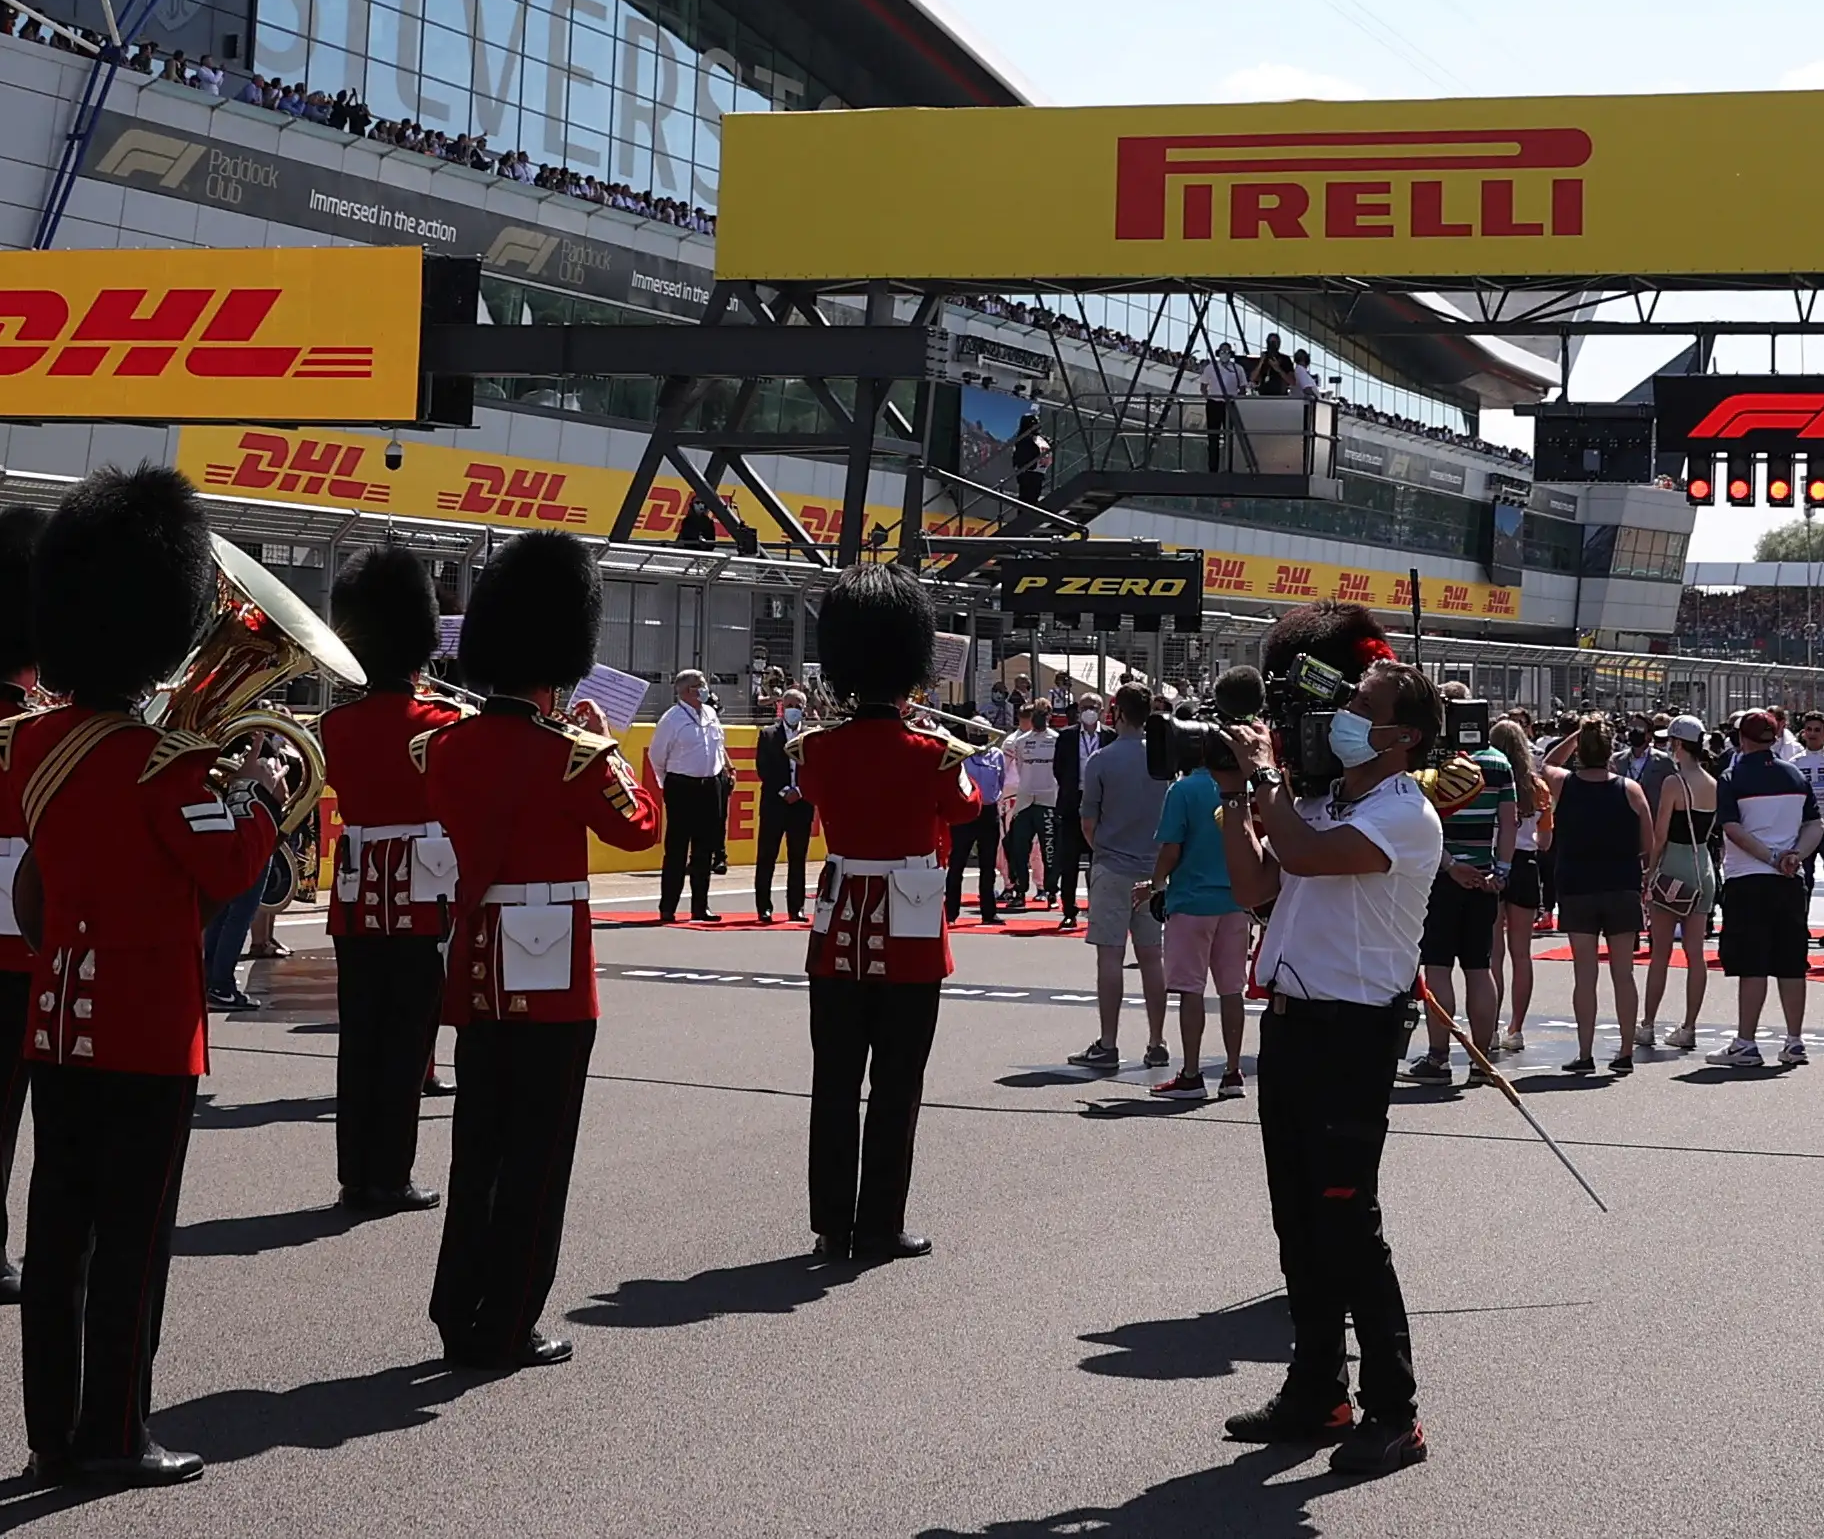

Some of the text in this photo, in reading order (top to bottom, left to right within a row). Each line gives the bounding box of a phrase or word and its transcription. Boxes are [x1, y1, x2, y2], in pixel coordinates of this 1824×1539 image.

[210, 149, 279, 189] Paddock
[1116, 128, 1592, 240] PIRELLI
[206, 174, 242, 204] Club
[309, 189, 457, 243] Immersed in the action
[562, 240, 612, 271] Paddock
[632, 270, 681, 298] Immersed
[682, 285, 691, 300] in
[692, 288, 710, 304] the
[231, 432, 371, 502] DHL
[460, 463, 569, 522] DHL
[1013, 576, 1187, 597] P ZERO
[1204, 557, 1245, 590] DHL
[1275, 565, 1311, 596] DHL
[1337, 573, 1370, 601] DHL
[1441, 585, 1468, 611] DHL
[1486, 590, 1510, 614] DHL
